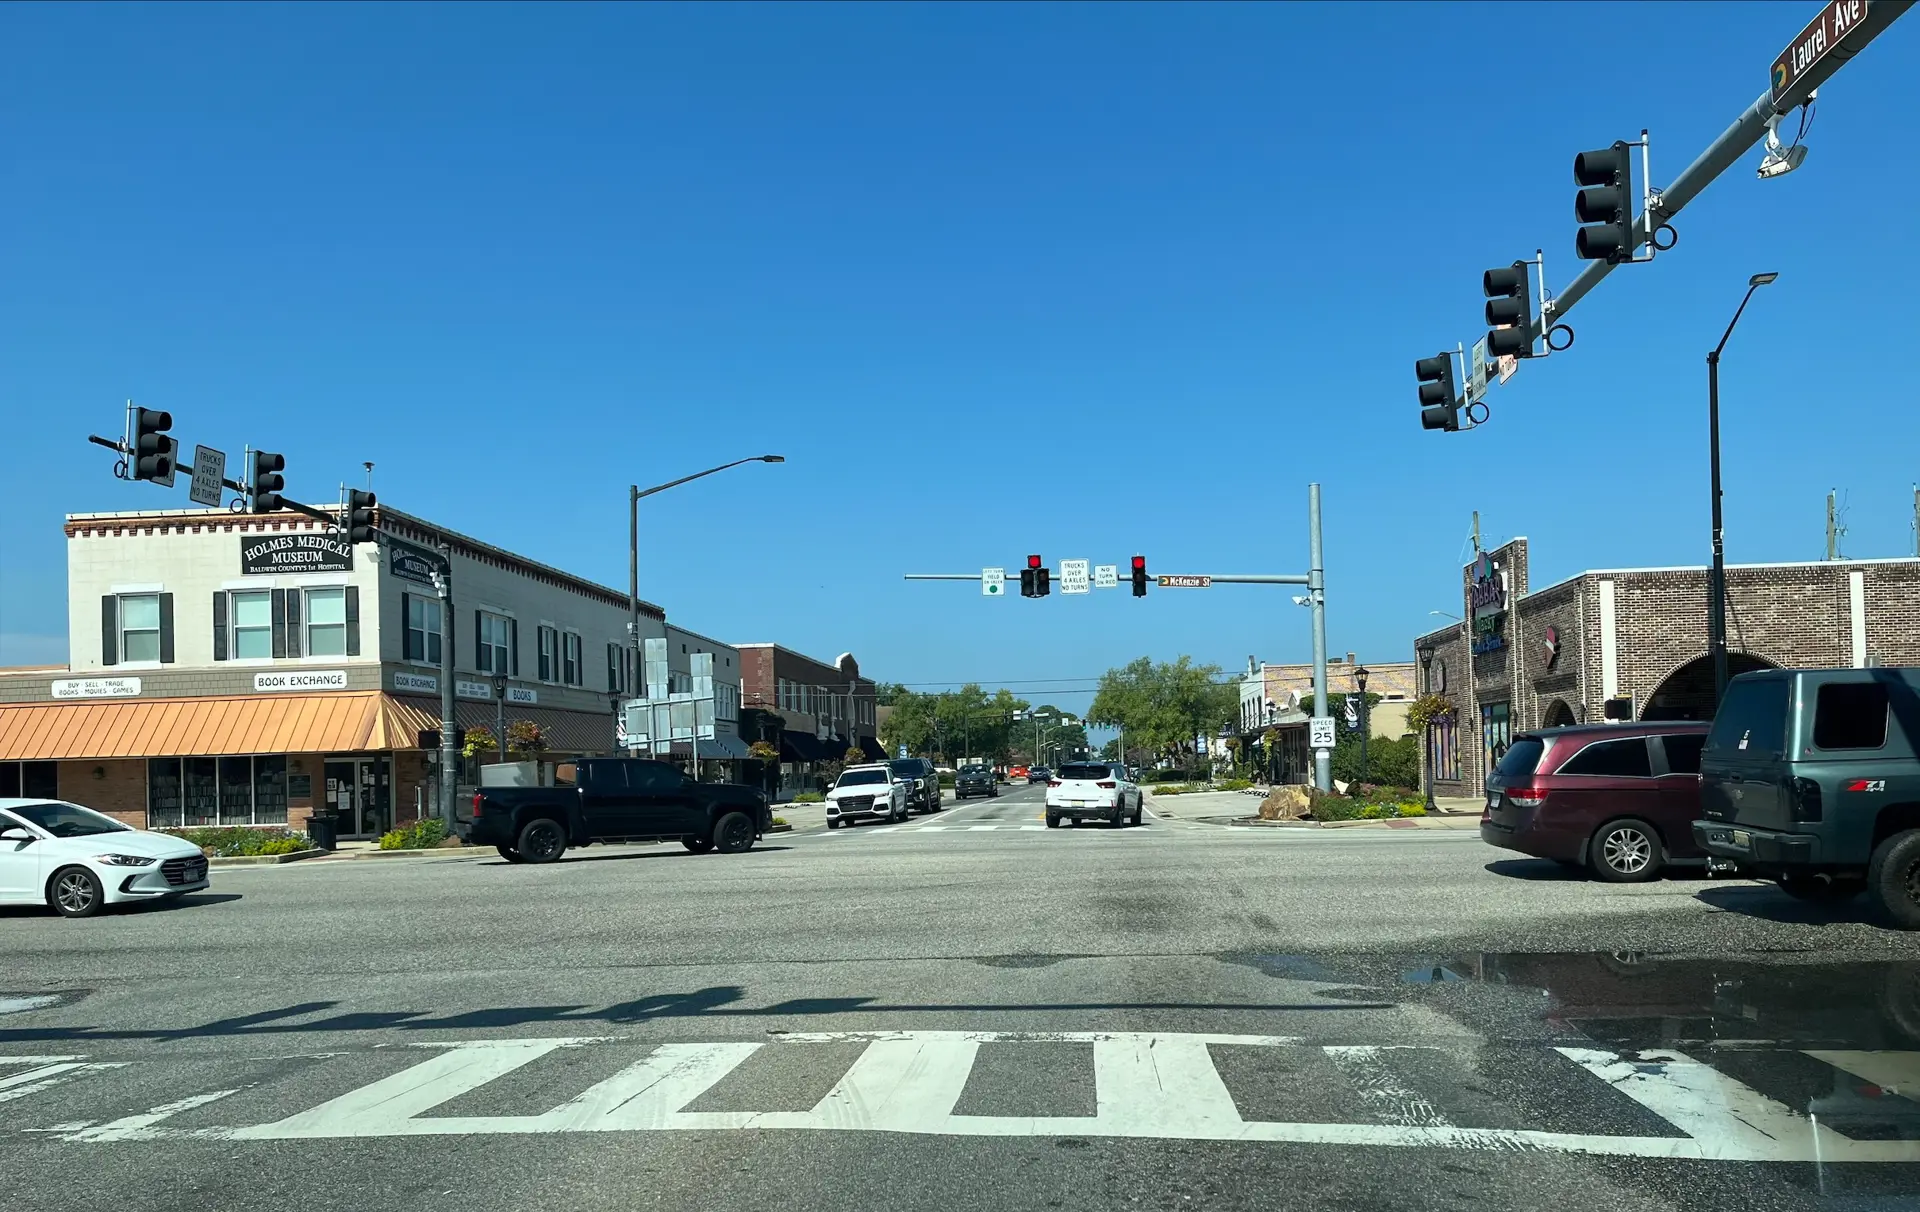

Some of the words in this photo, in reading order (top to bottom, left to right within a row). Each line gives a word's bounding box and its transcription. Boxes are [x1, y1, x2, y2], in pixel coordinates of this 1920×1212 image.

[1792, 16, 1827, 76] Laurel
[1833, 0, 1859, 37] Ave
[200, 451, 221, 466] TRUCKS
[201, 464, 217, 476] OVER
[195, 475, 200, 485] 4
[201, 477, 219, 490] AXLES
[192, 486, 200, 497] NO
[202, 488, 220, 502] TURNS
[244, 536, 294, 562] HOLMES
[297, 536, 351, 558] MEDICAL
[272, 551, 323, 563] MUSEUM
[250, 565, 277, 573] BALDWIN
[278, 564, 307, 572] COUNTY'S
[404, 559, 429, 575] MUSEUM
[1170, 576, 1200, 586] McKenzie
[1202, 577, 1210, 586] St
[258, 677, 285, 687] BOOK
[290, 675, 343, 685] EXCHANGE
[396, 676, 409, 686] BOOK
[411, 677, 435, 689] EXCHANGE
[84, 687, 107, 695] MOVIES
[112, 686, 134, 694] GAMES
[512, 688, 532, 701] BOOKS
[1313, 732, 1333, 743] 25
